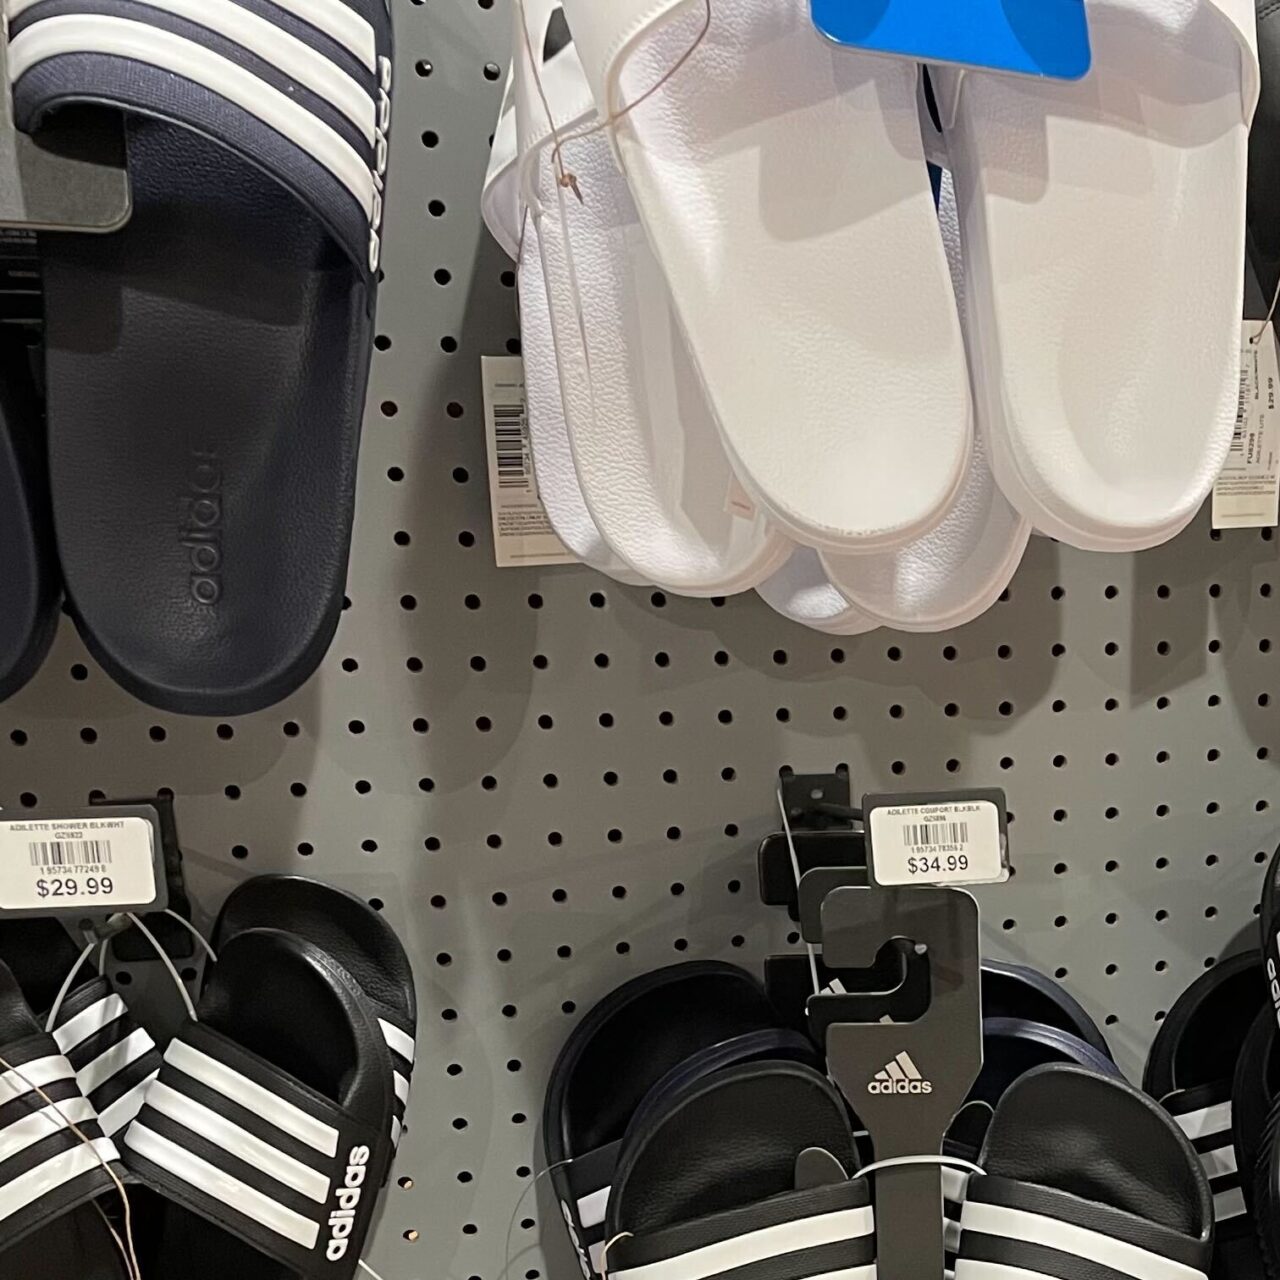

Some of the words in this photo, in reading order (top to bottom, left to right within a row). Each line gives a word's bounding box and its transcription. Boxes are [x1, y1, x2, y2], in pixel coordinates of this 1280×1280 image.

[10, 823, 49, 832] ADILETTE
[51, 822, 88, 830] SHOWER
[907, 855, 968, 874] $34.99
[36, 877, 113, 898] $29.99
[867, 1079, 933, 1094] adidas
[325, 1145, 370, 1261] adidas
